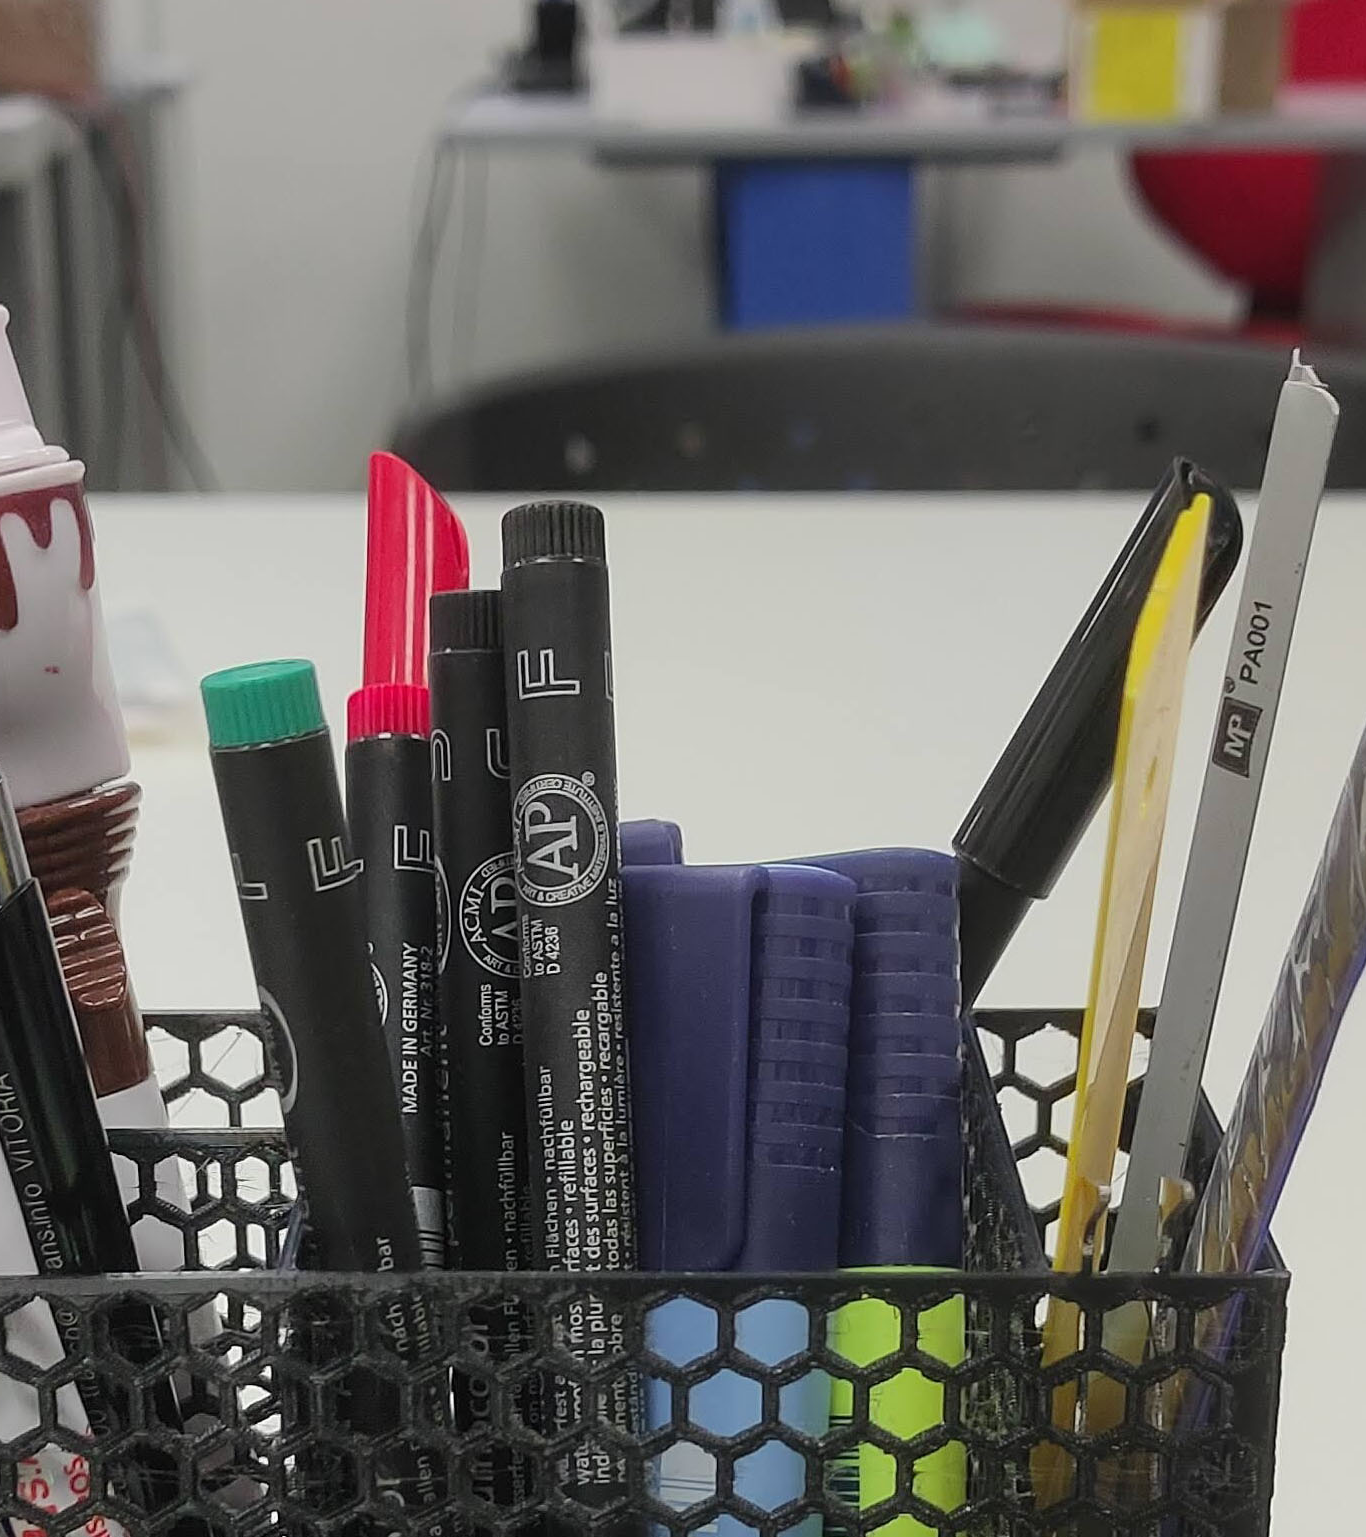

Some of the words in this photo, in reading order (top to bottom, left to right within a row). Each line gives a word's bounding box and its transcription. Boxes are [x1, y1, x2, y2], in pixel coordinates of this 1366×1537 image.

[1240, 600, 1273, 685] PA001
[517, 647, 581, 701] F
[1223, 713, 1252, 759] MP
[525, 801, 580, 882] AP
[463, 885, 488, 944] ACMI
[605, 877, 618, 905] luz
[420, 945, 434, 991] 318-2
[530, 919, 544, 961] ASTM
[546, 963, 562, 975] D
[401, 942, 419, 1034] GERMANY
[478, 983, 492, 1047] Conforms
[494, 990, 509, 1028] ASTM
[610, 951, 624, 1040] resistente
[401, 1037, 418, 1056] IN
[591, 971, 613, 1071] recargable
[401, 1060, 419, 1115] MADE
[572, 1009, 597, 1131] rechargeable
[538, 1065, 556, 1171] nachfüllbar
[597, 1087, 620, 1184] superficies
[496, 1131, 517, 1232] nachfüllbar
[555, 1119, 578, 1202] refillable
[580, 1147, 600, 1225] surfaces
[25, 1182, 63, 1271] ans.info
[545, 1188, 560, 1260] Flächen
[601, 1188, 618, 1214] las
[561, 1218, 582, 1273] rfaces
[583, 1230, 601, 1259] des
[602, 1219, 620, 1271] todas
